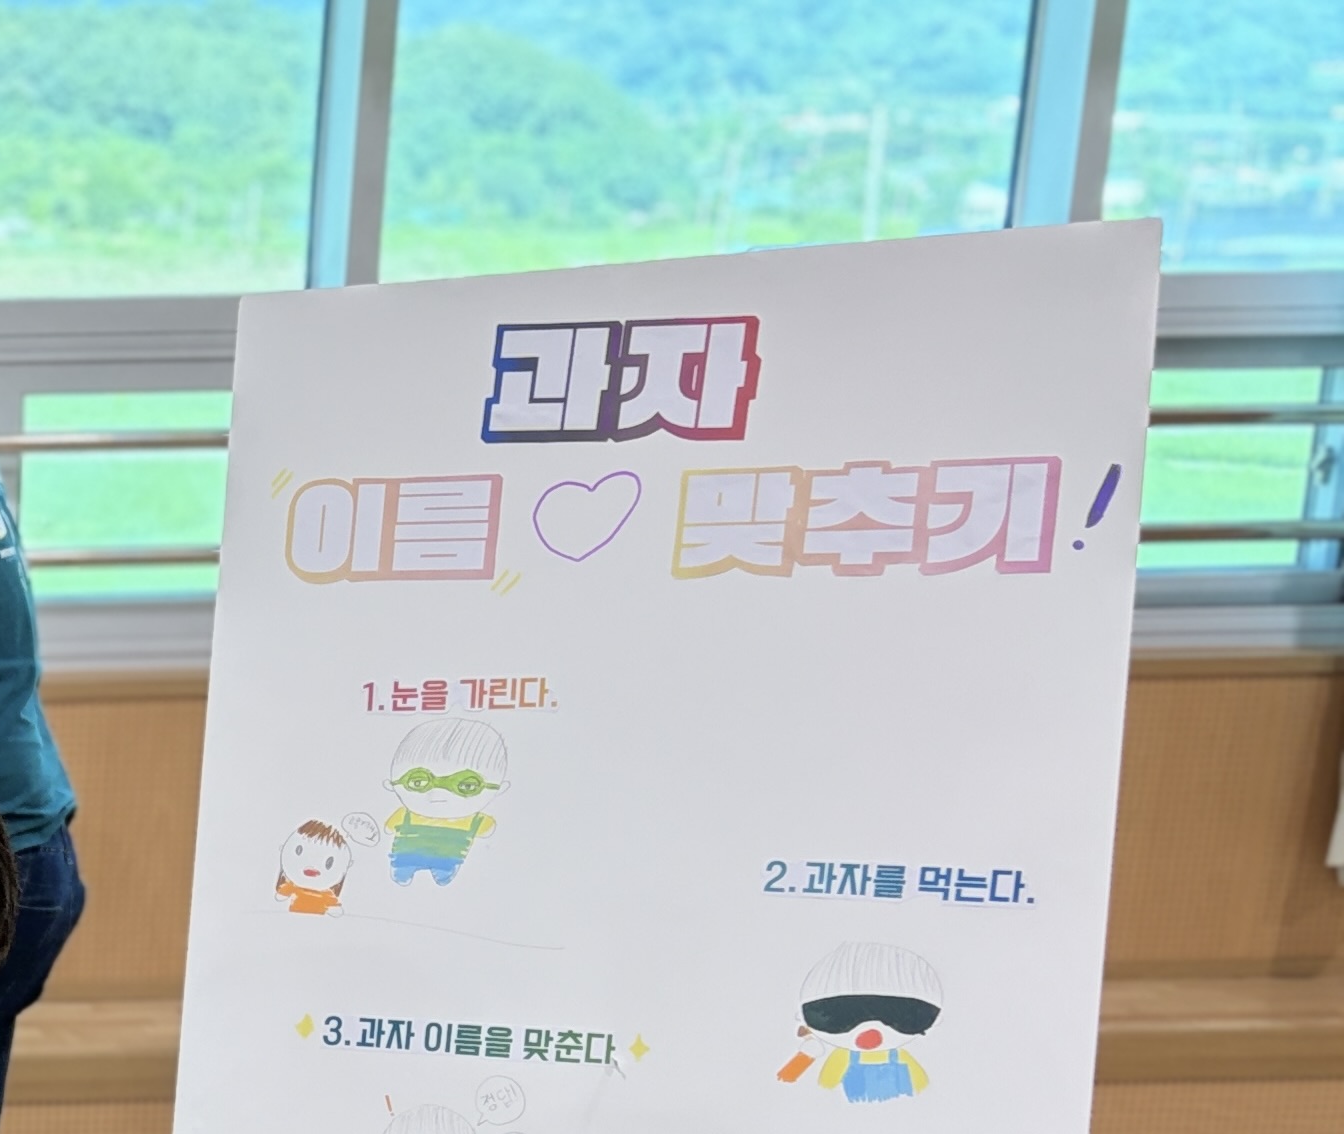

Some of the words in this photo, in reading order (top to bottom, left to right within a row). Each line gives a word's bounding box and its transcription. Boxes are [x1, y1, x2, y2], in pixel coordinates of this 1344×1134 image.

[481, 315, 761, 443] 과자
[286, 473, 503, 584] 이름
[459, 677, 558, 710] 가린다.
[917, 865, 1035, 904] 먹는다.
[424, 1022, 513, 1058] 이름을
[523, 1028, 616, 1064] 맞춘다
